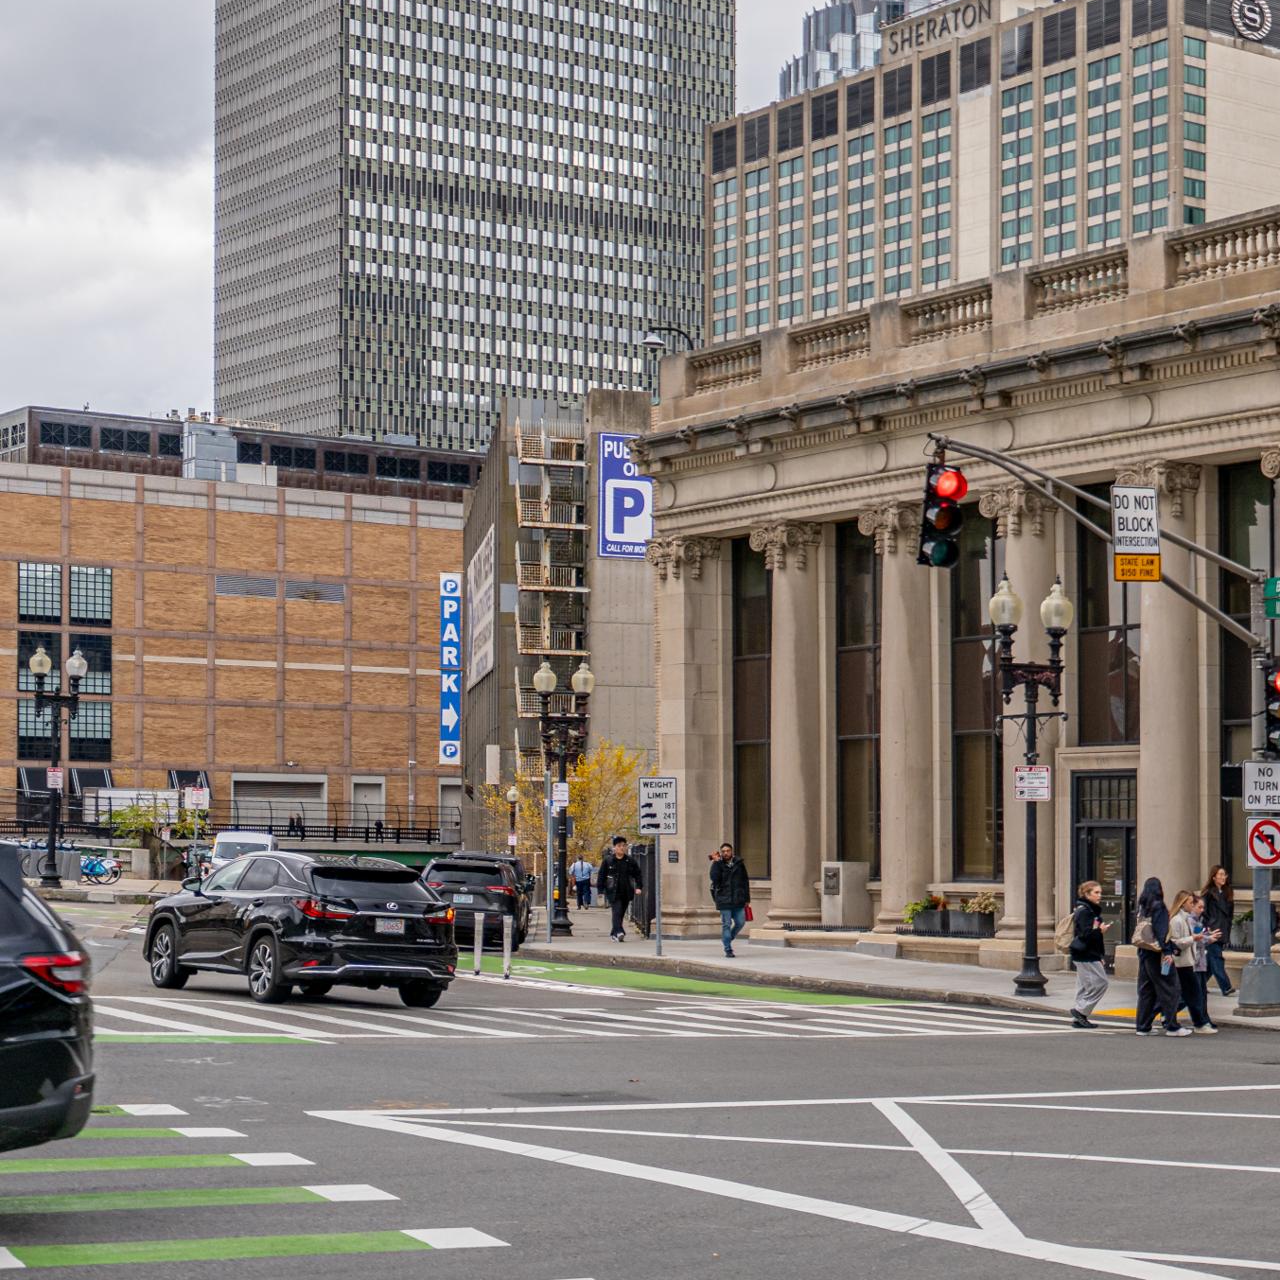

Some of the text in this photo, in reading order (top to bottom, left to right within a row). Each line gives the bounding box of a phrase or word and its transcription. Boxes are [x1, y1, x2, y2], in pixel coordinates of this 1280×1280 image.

[1114, 495, 1155, 511] DO NOT
[612, 486, 645, 534] P
[1118, 517, 1154, 532] BLOCK
[1115, 536, 1158, 547] INTERSECTION
[606, 543, 621, 553] CALL
[621, 544, 634, 554] FOR
[1120, 558, 1155, 567] STATE LAW
[1120, 568, 1155, 577] $150 FINE
[441, 599, 459, 693] PARK
[1257, 767, 1274, 777] NO
[642, 781, 673, 789] WEIGHT
[1253, 781, 1279, 791] TURN
[1247, 795, 1261, 805] ON
